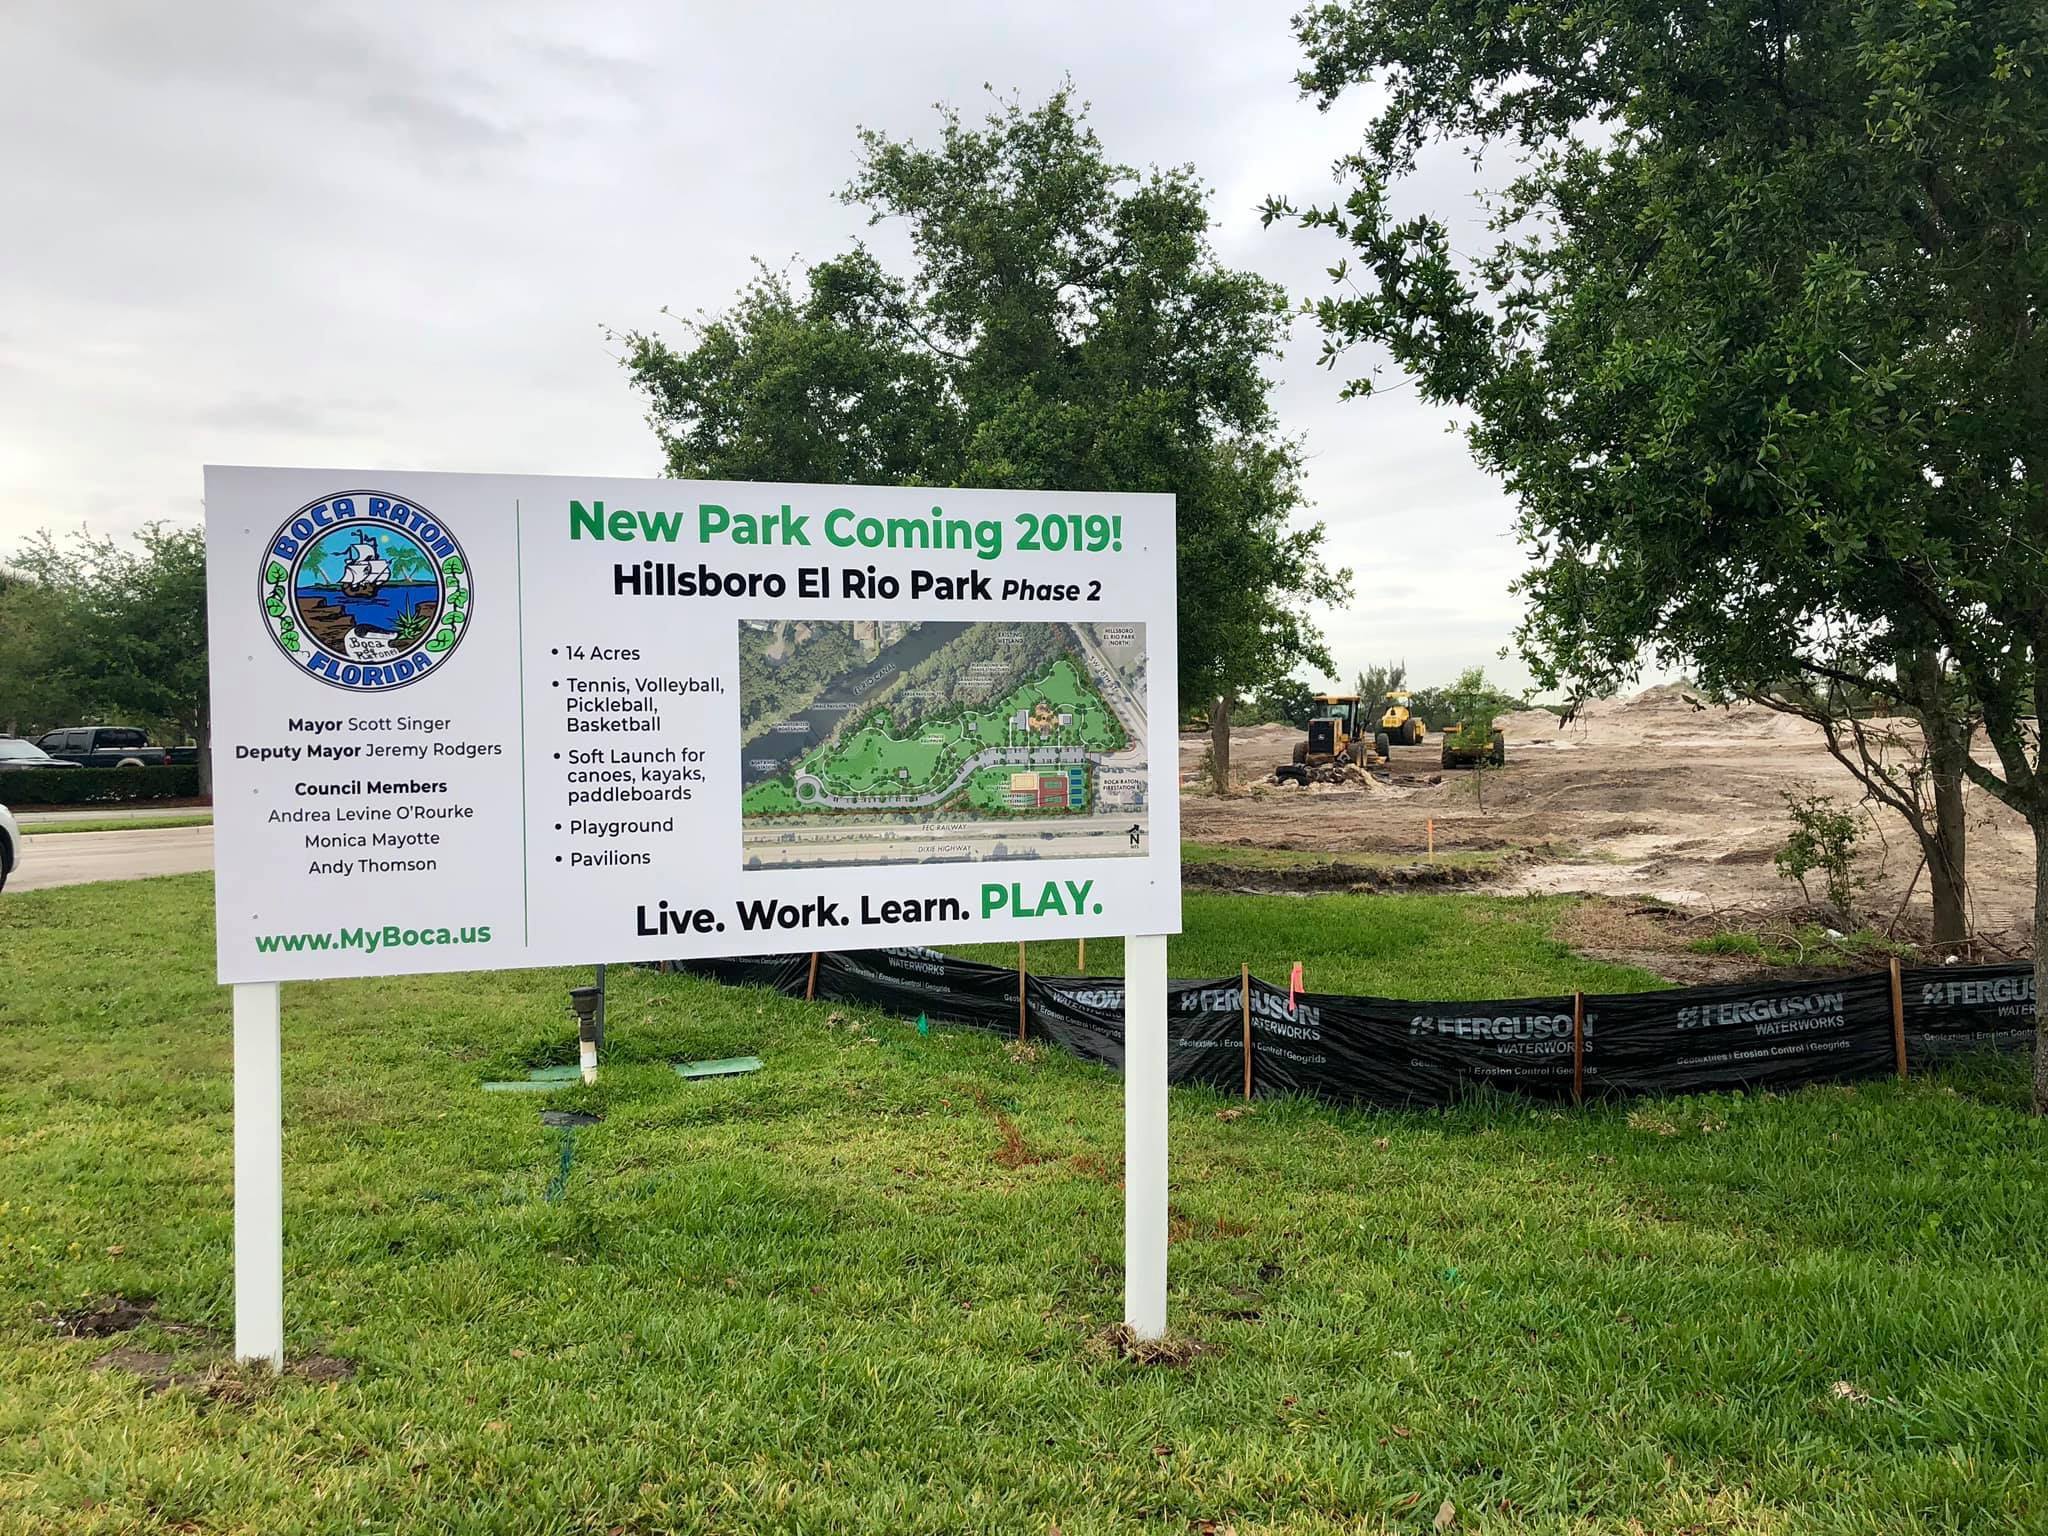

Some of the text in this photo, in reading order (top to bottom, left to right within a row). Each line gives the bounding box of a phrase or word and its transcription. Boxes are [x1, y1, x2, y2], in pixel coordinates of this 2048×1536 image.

[273, 497, 455, 560] BOCA RATON
[569, 500, 1123, 561] New Park Coming 2019!
[613, 559, 1102, 601] Hillsboro El Rio Park Phase 2
[349, 637, 385, 649] Boca
[566, 646, 641, 661] 14 Acres
[307, 651, 433, 686] FLORIDA
[567, 677, 725, 695] Tennis, Volleyball,
[566, 697, 658, 714] Pickleball,
[288, 716, 451, 735] Mayor Scott Singer
[567, 717, 661, 732] Basketball
[235, 741, 502, 761] Deputy Mayor Jeremy Rodgers
[568, 747, 706, 764] Soft Launch for
[567, 766, 706, 784] canoes, kayaks,
[295, 778, 448, 796] Council Members
[568, 785, 692, 806] paddleboards
[268, 804, 474, 824] Andrea Levine O'Rourke
[570, 817, 674, 837] Playground
[305, 831, 441, 849] Monica Mayotte
[1129, 834, 1140, 845] N
[308, 858, 437, 876] Andy Thomson
[571, 850, 651, 867] Pavilions
[637, 880, 1103, 937] Live. Work. Learn. PLAY.
[255, 926, 492, 953] www.MyBoca.us
[888, 956, 945, 977] WATERWORKS
[1040, 1004, 1065, 1021] Erosion
[1702, 992, 1844, 1027] FERGUSON
[1755, 1015, 1845, 1036] WATERWORKS
[1497, 1041, 1593, 1054] WATERWORS
[1733, 1048, 1769, 1060] Erosion
[1771, 1045, 1805, 1056] Control
[1810, 1039, 1851, 1051] Geogrids
[1286, 1051, 1327, 1064] Geogrids
[1474, 1066, 1512, 1076] Erosion
[1514, 1066, 1550, 1076] Control
